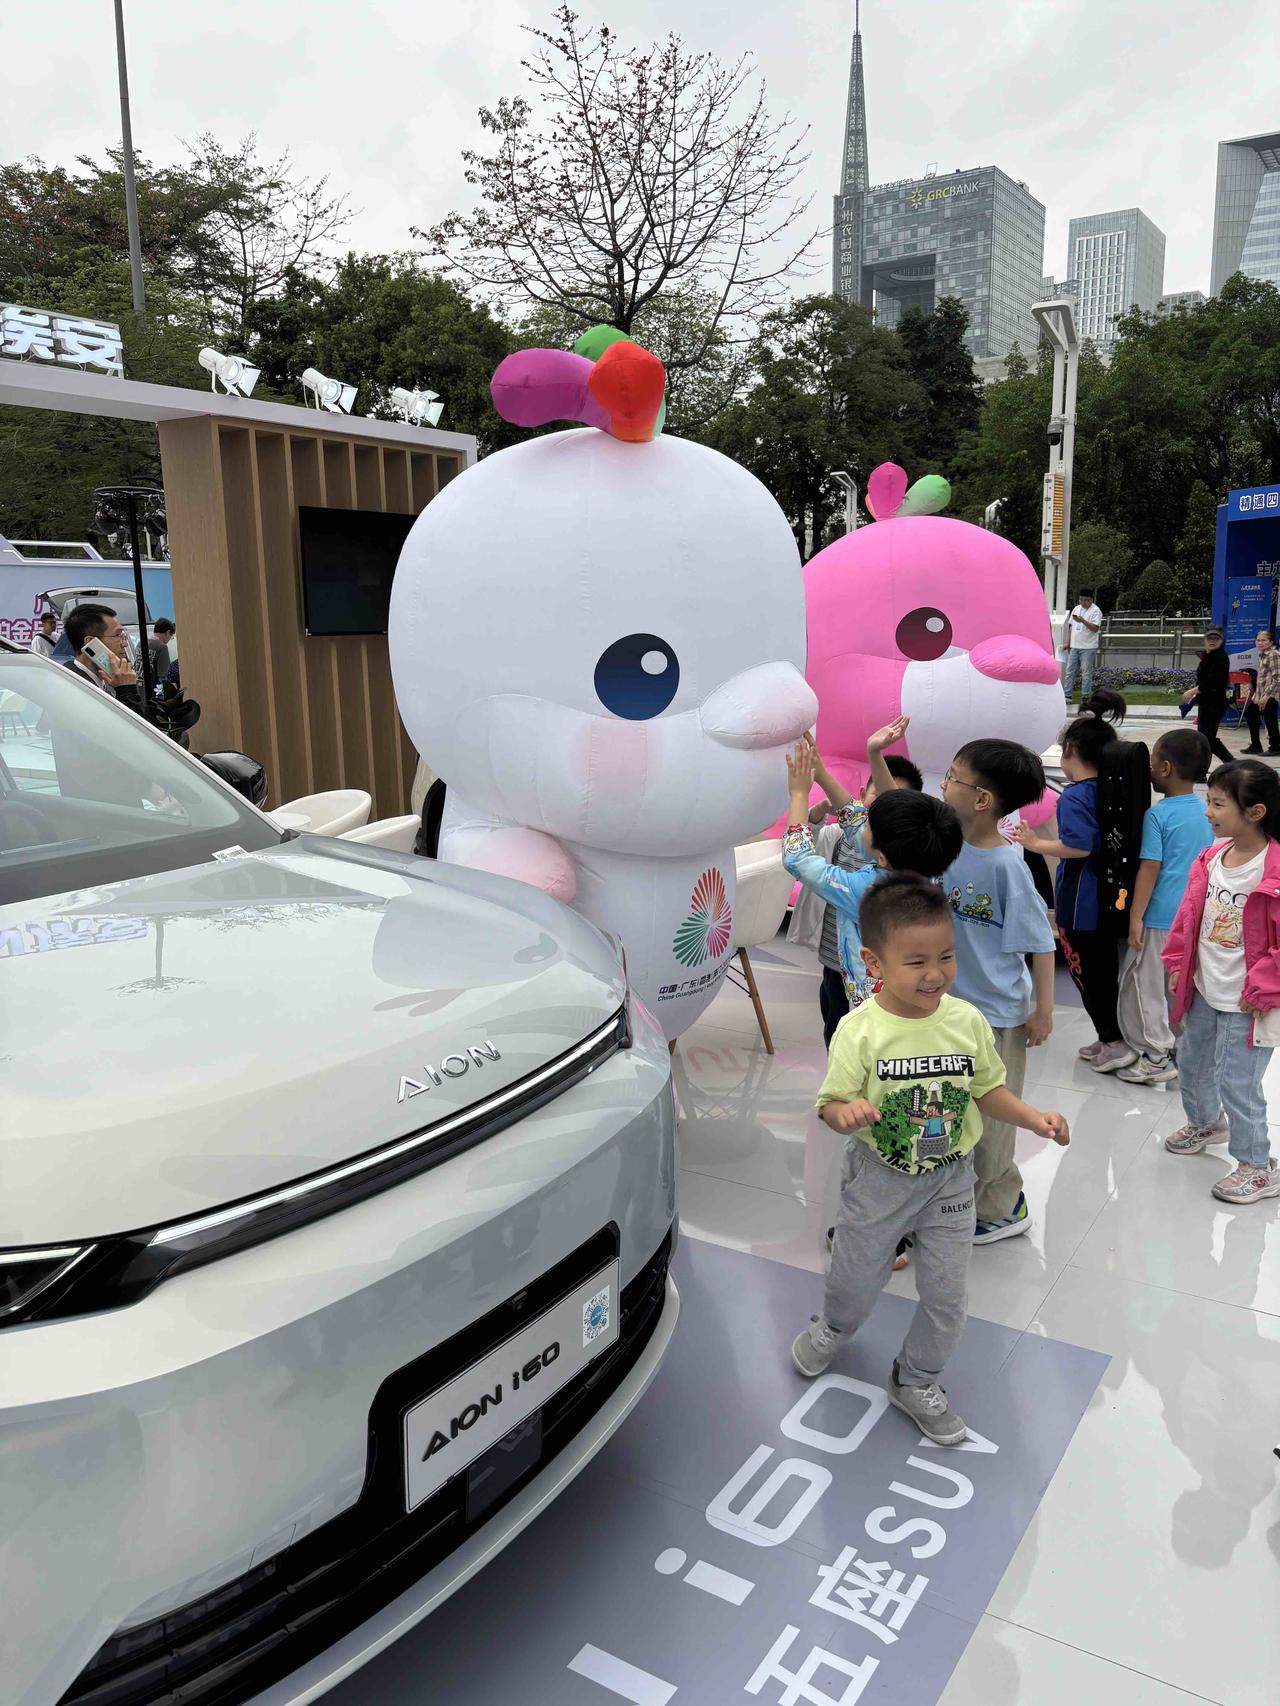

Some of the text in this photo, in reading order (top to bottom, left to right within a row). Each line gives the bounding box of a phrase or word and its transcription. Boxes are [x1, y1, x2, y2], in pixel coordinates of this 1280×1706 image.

[927, 181, 980, 201] GRCBANK
[397, 1040, 501, 1104] AION
[421, 1341, 560, 1462] AION i60
